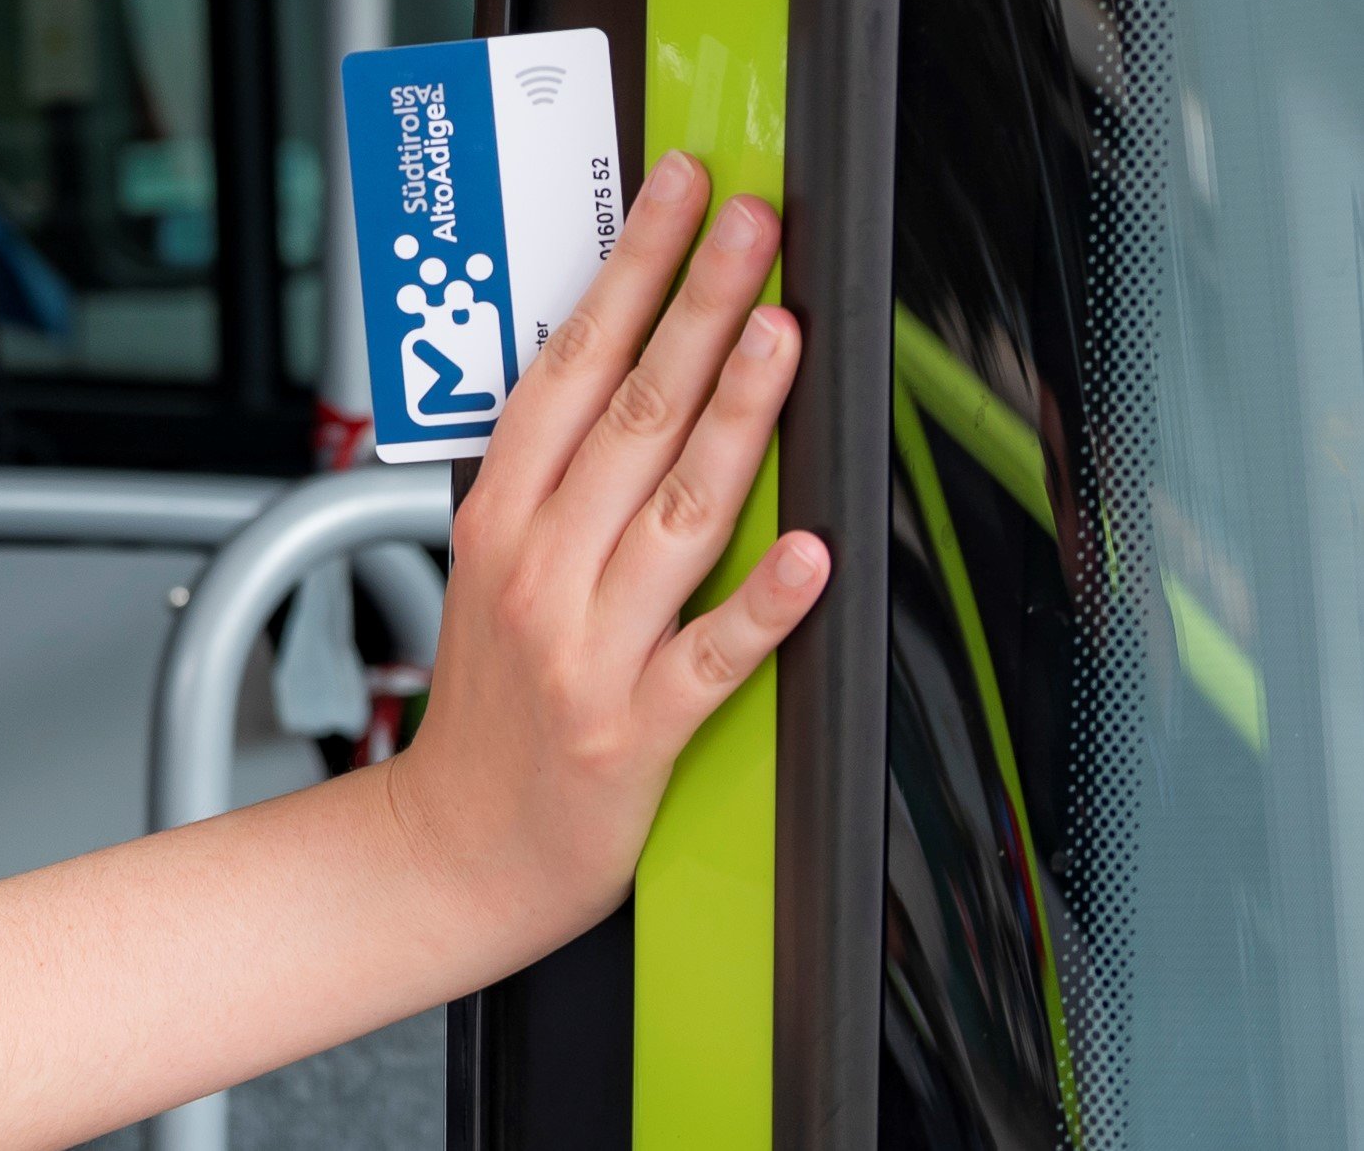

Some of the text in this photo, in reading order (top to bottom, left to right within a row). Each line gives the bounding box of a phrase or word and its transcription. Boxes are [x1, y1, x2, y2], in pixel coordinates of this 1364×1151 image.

[390, 83, 445, 108] PASS
[392, 106, 428, 214] Südtirol
[423, 103, 458, 244] AltoAdige
[591, 156, 610, 180] 52
[535, 321, 549, 352] ter
